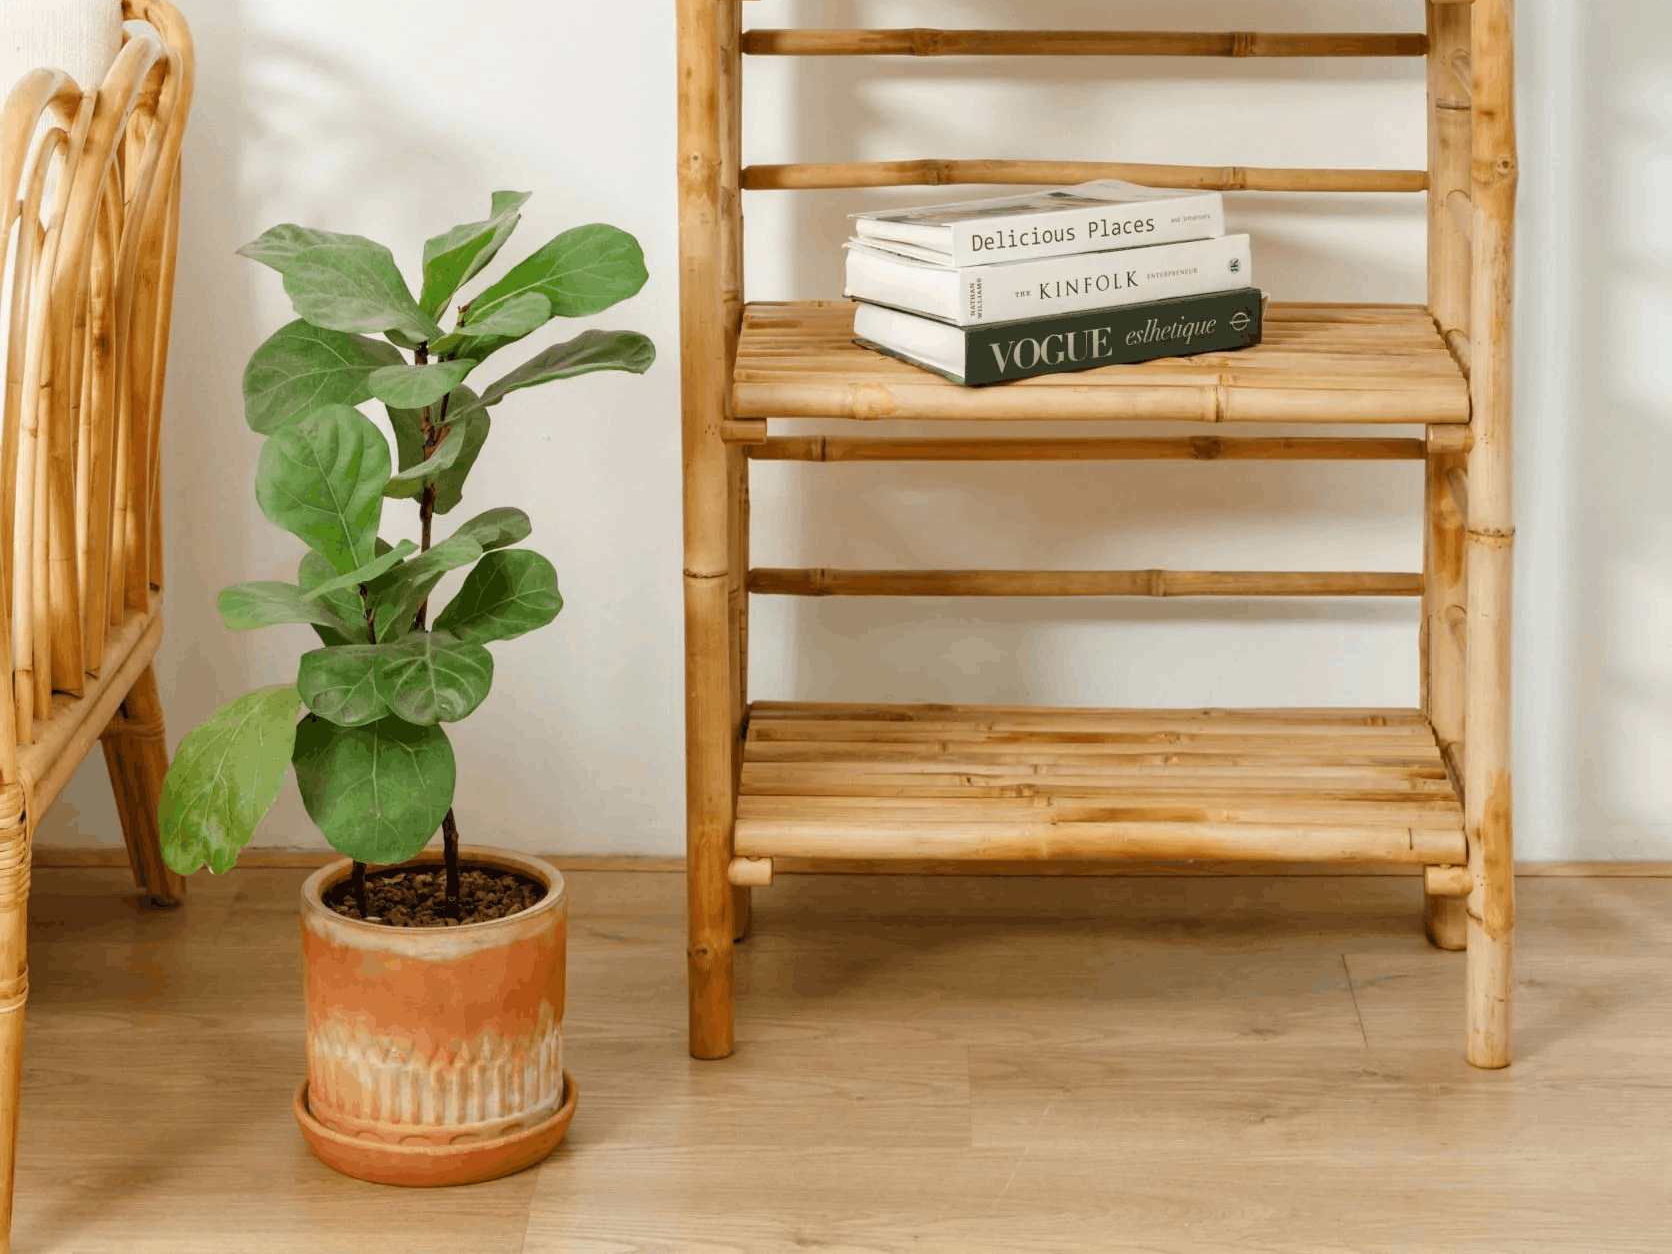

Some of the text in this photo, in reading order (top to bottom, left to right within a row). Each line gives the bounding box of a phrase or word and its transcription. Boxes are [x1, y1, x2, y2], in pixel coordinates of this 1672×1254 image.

[972, 226, 1076, 252] Delicious
[1088, 218, 1155, 239] Places
[1014, 290, 1031, 298] THE
[1039, 270, 1139, 300] KINFOLK
[988, 326, 1113, 374] VOGUE
